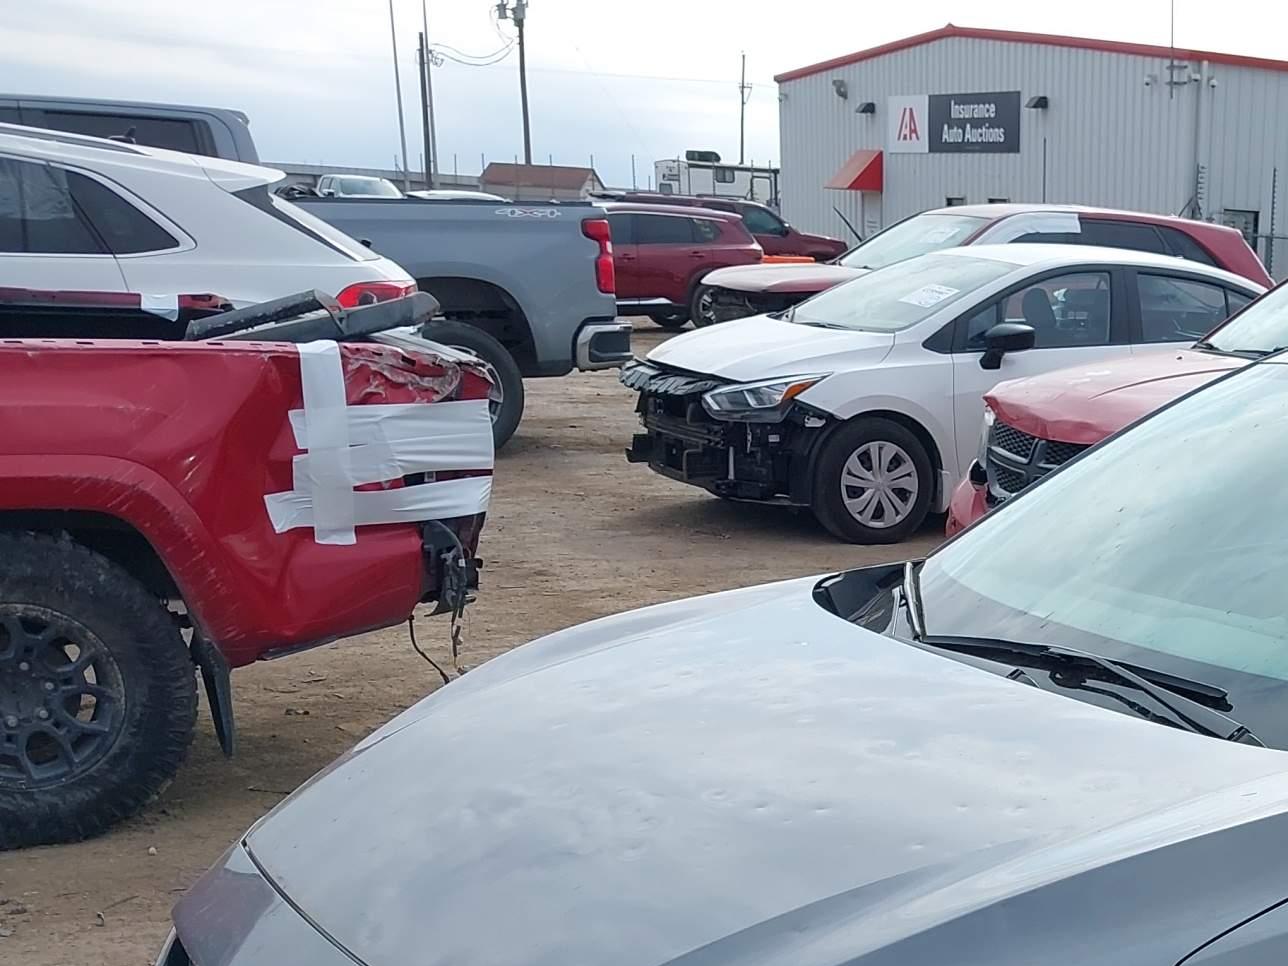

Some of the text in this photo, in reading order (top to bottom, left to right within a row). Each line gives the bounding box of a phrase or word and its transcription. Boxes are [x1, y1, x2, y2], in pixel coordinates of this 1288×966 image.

[951, 99, 996, 118] Insurance
[942, 123, 1005, 143] Auto Auctions
